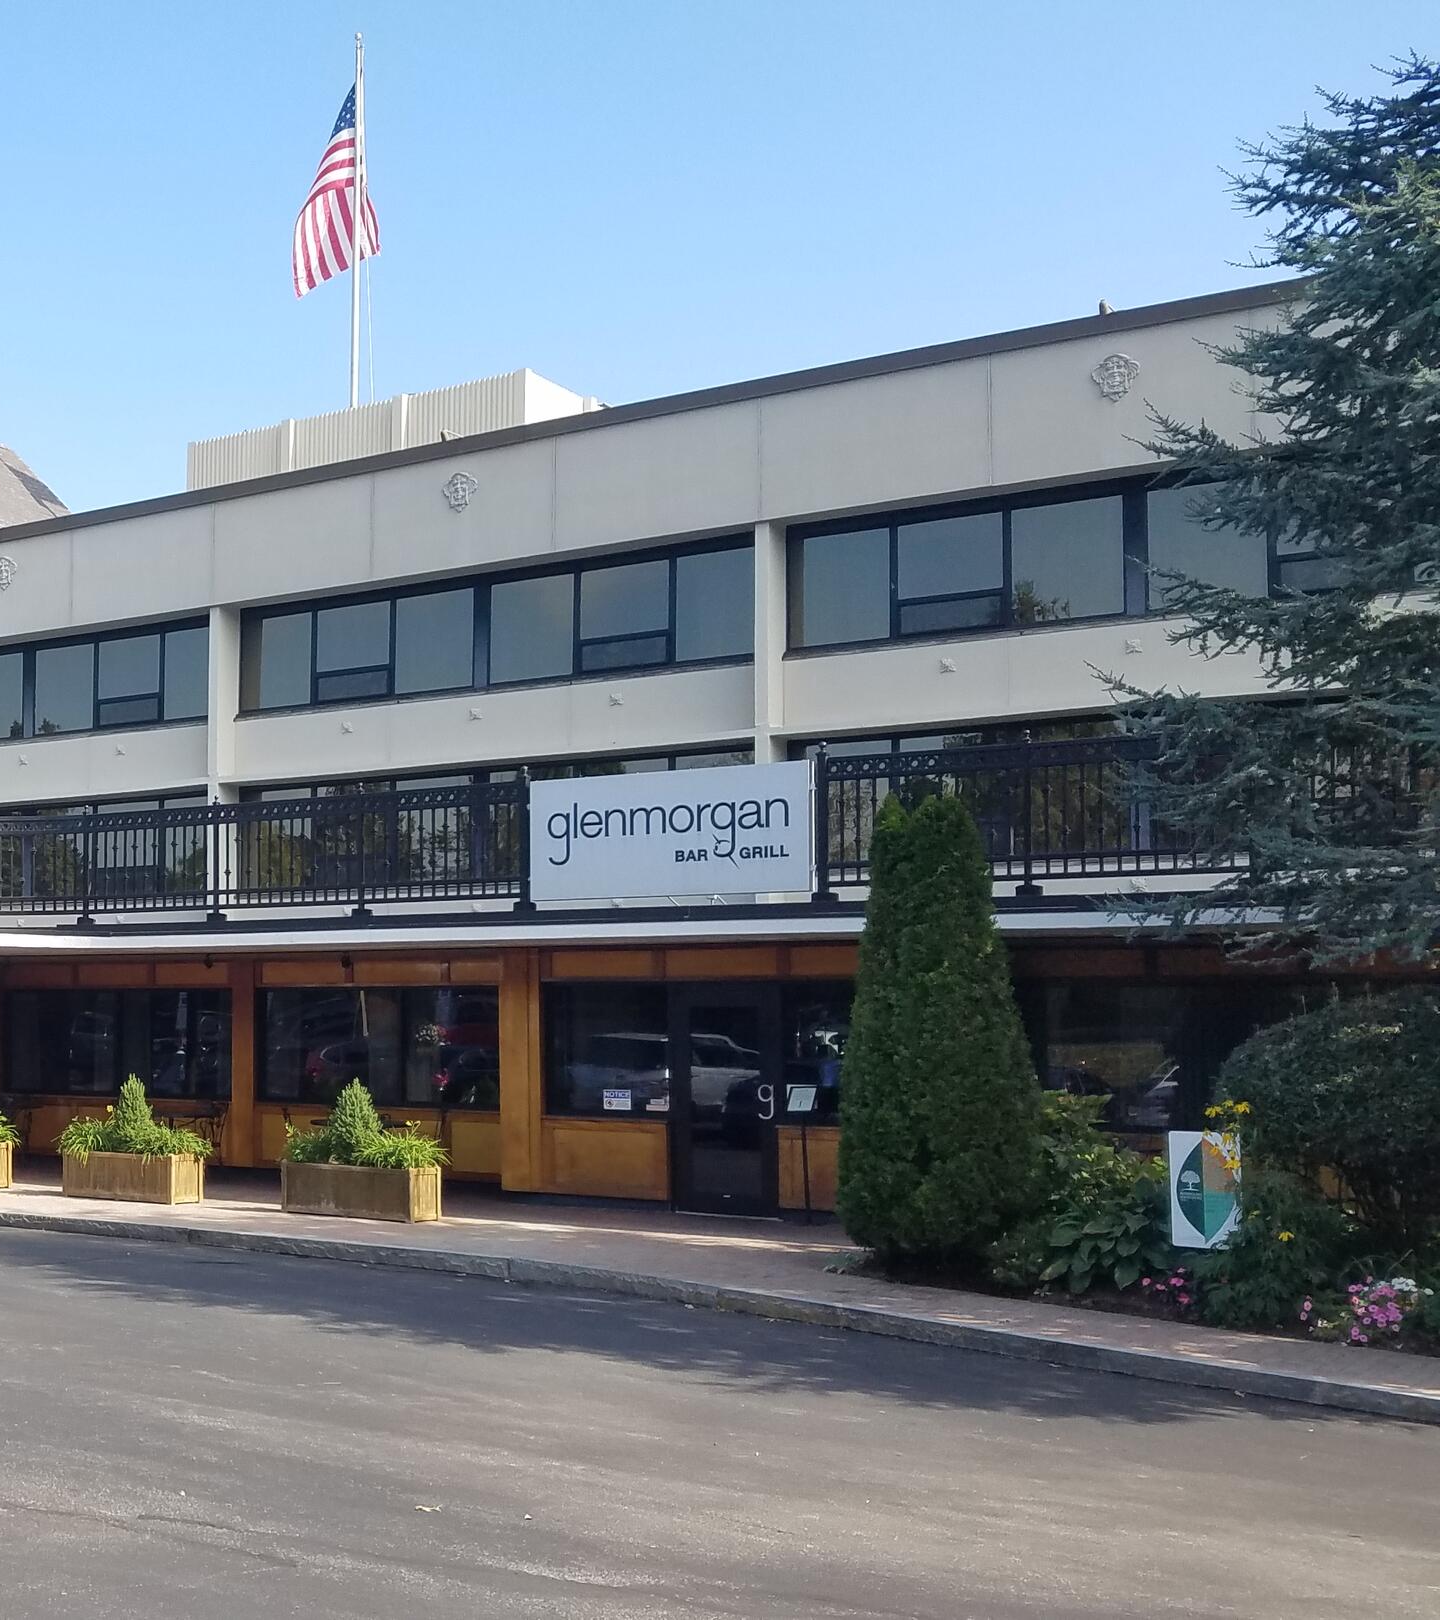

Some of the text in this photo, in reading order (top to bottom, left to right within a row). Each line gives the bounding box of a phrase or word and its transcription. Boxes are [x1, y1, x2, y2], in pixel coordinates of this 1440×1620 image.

[547, 797, 790, 866] glenmorgan
[675, 844, 790, 862] BAR GRILL
[604, 1091, 630, 1099] NOTICE
[757, 1084, 774, 1120] g
